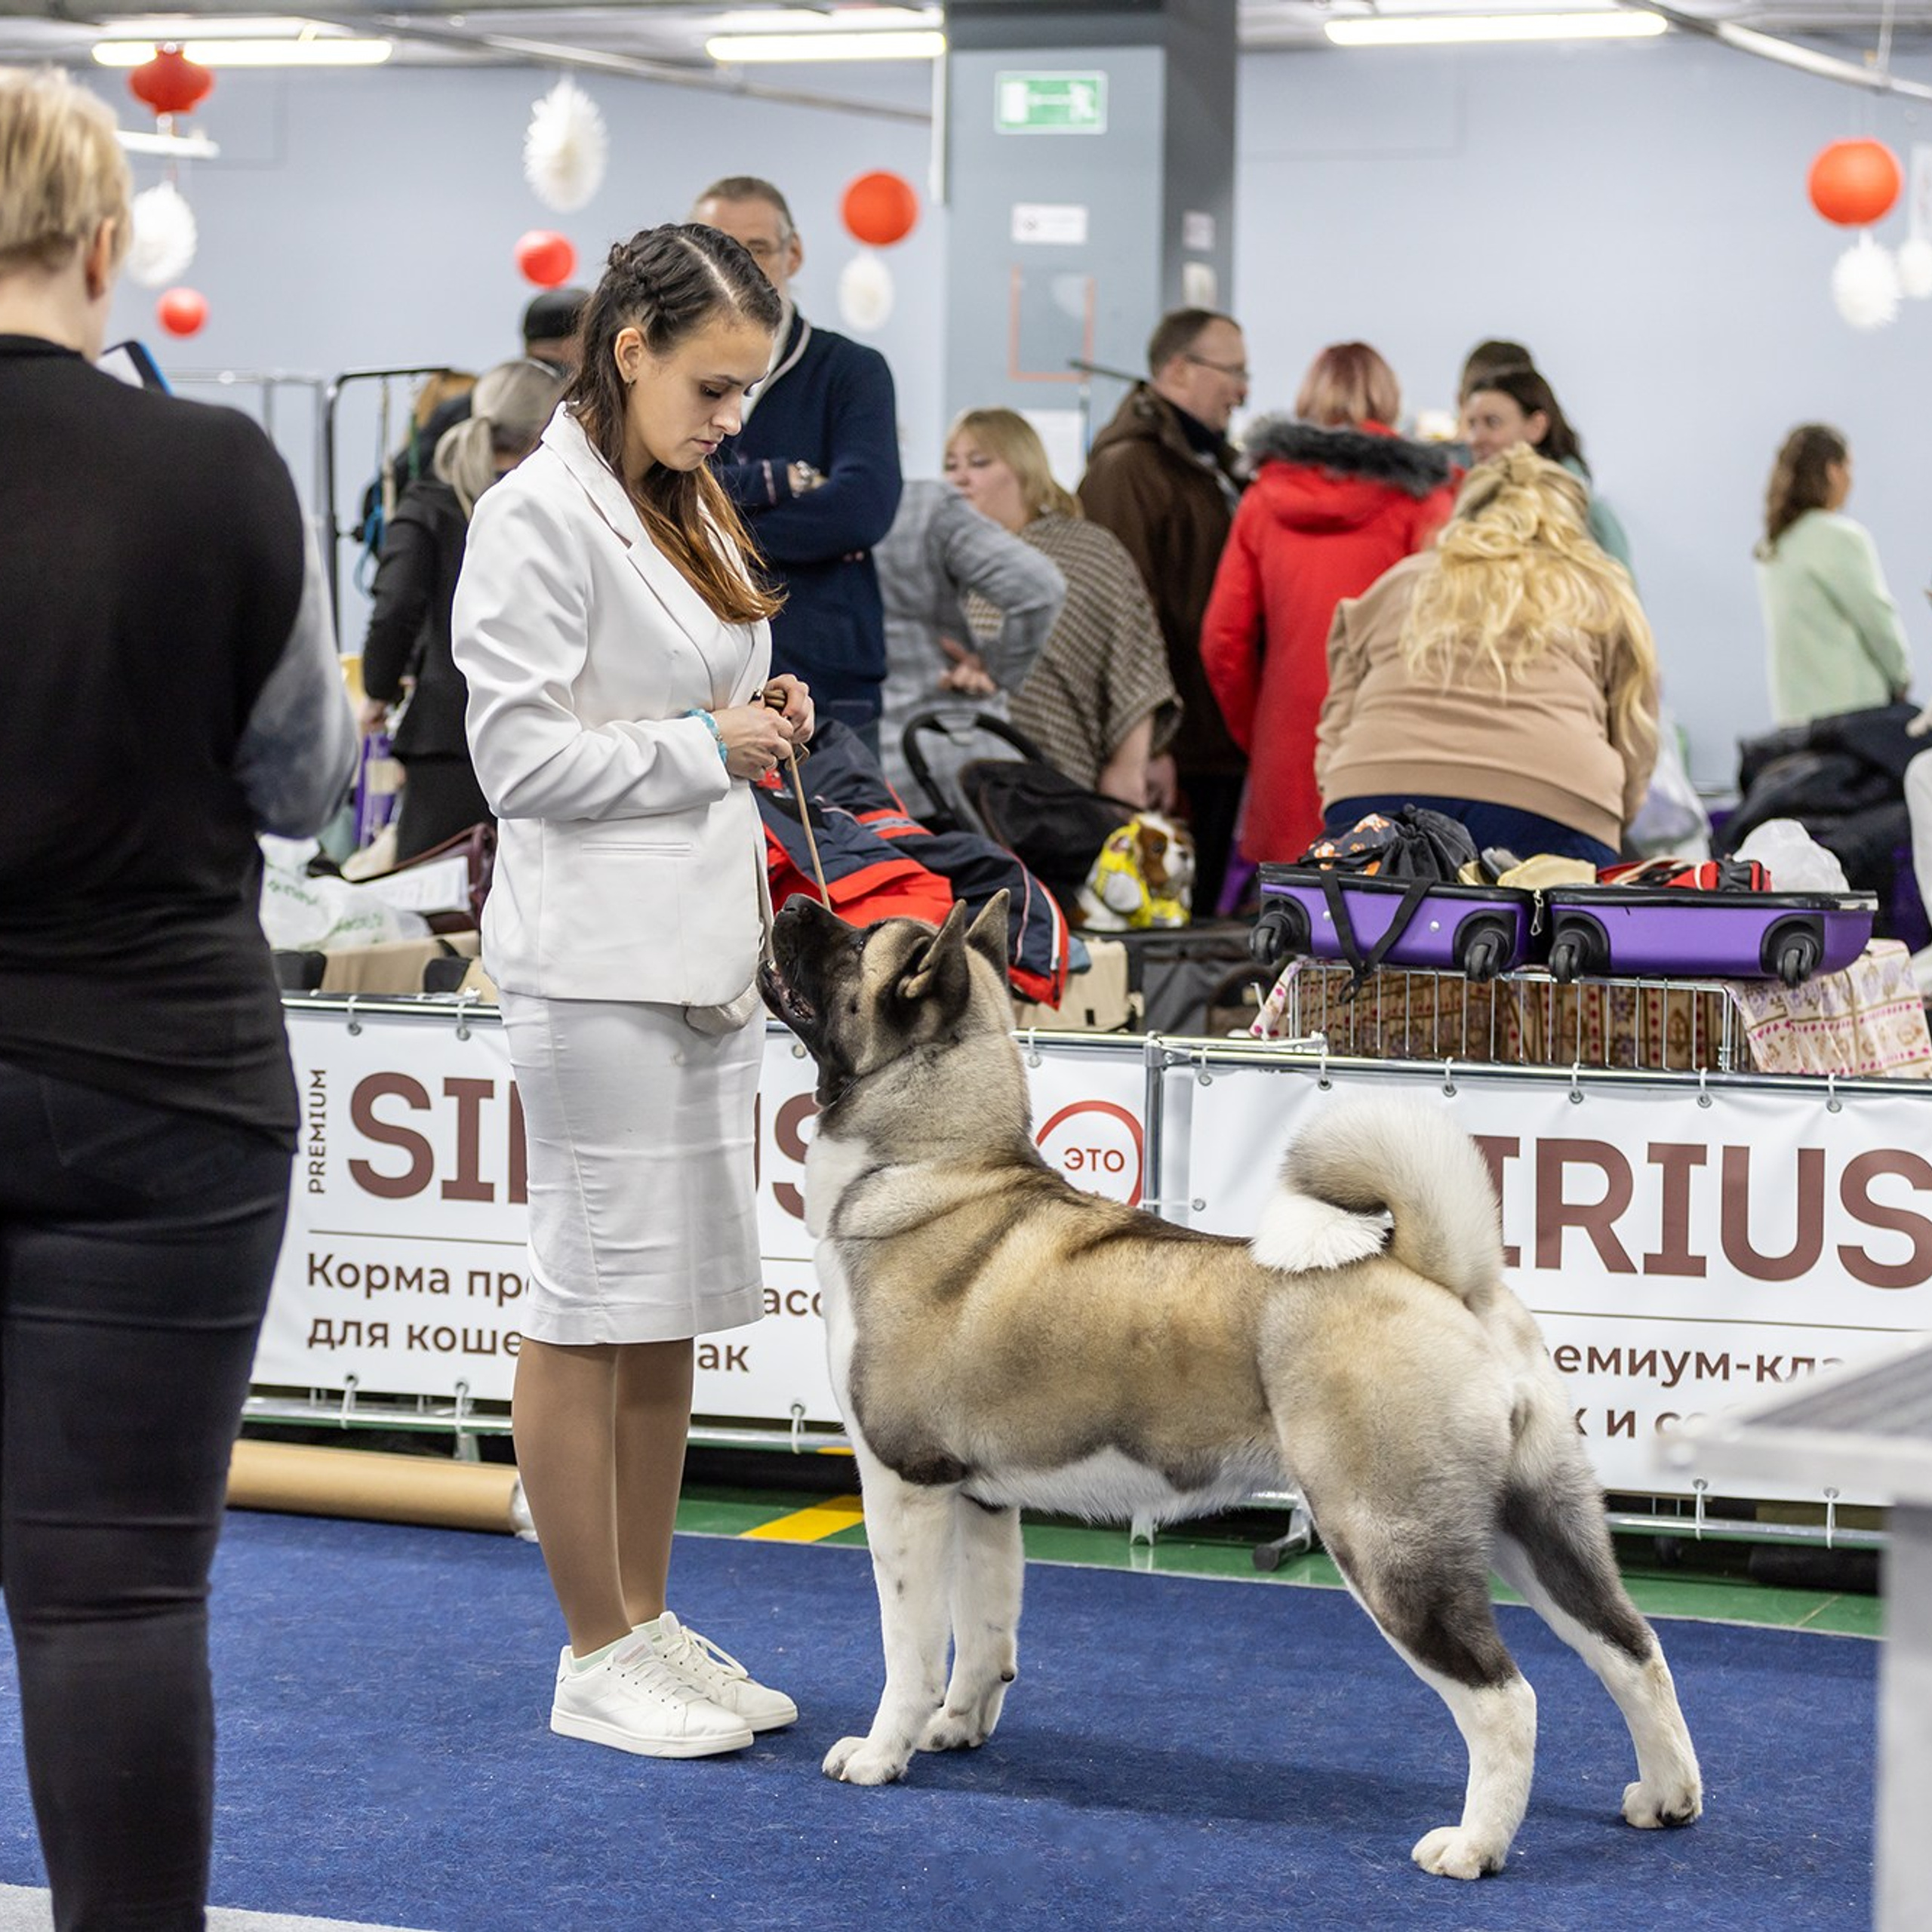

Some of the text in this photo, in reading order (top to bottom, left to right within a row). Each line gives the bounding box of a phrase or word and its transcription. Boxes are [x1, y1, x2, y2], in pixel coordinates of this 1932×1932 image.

[307, 1068, 328, 1195] PREMIUM
[1063, 1146, 1125, 1174] ЭТО
[307, 1252, 451, 1300] Корма
[307, 1318, 389, 1350] для
[407, 1324, 523, 1358] коше
[1544, 1344, 1845, 1389] емиум-кл
[1606, 1408, 1636, 1439] и
